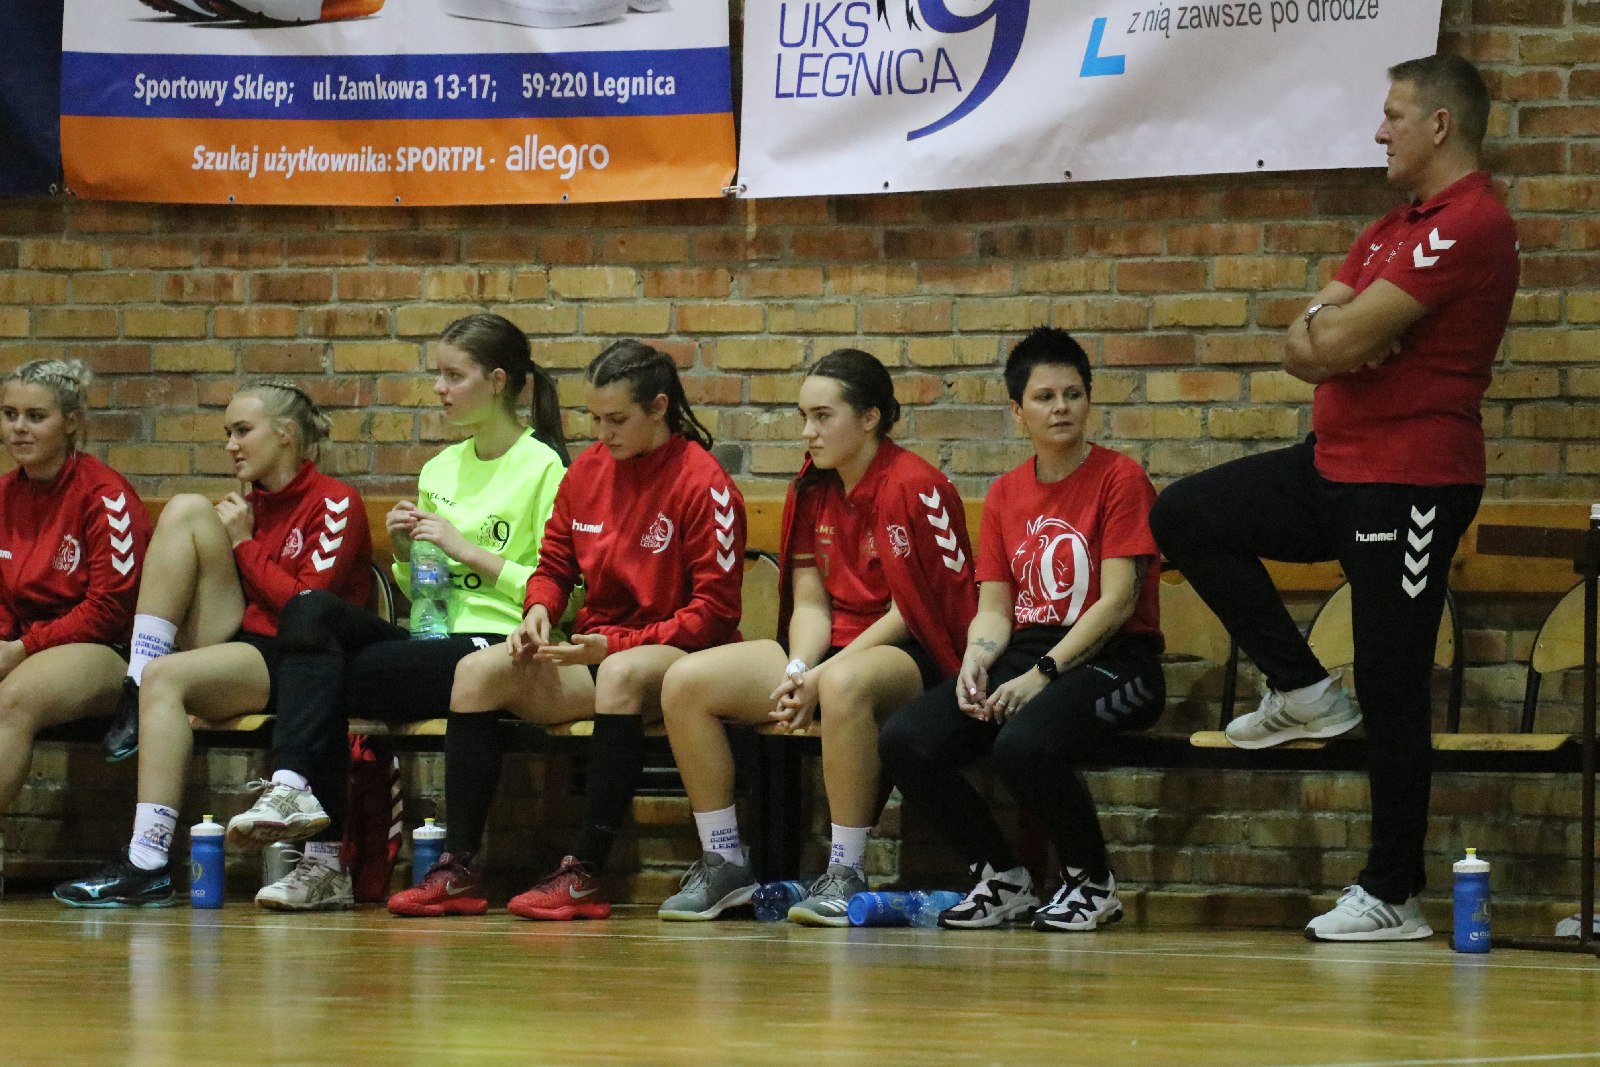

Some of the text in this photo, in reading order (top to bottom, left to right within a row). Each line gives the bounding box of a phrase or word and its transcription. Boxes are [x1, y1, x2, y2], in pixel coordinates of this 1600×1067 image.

[779, 1, 871, 48] UKS
[1142, 8, 1170, 38] nią
[1177, 2, 1263, 30] zawsze
[1271, 0, 1299, 32] po
[134, 69, 676, 107] Sportowy Sklep; ul.Zamkowa 13-17; 59-220 Legnica
[775, 47, 963, 98] LEGNICA
[191, 145, 258, 178] Szukaj
[264, 145, 393, 179] użytkownika:
[396, 146, 486, 172] SPORTPL
[505, 134, 610, 180] allegro
[1355, 529, 1398, 542] hummel
[1018, 590, 1034, 607] KS
[1041, 533, 1090, 626] 9
[1014, 603, 1061, 624] EGNICA
